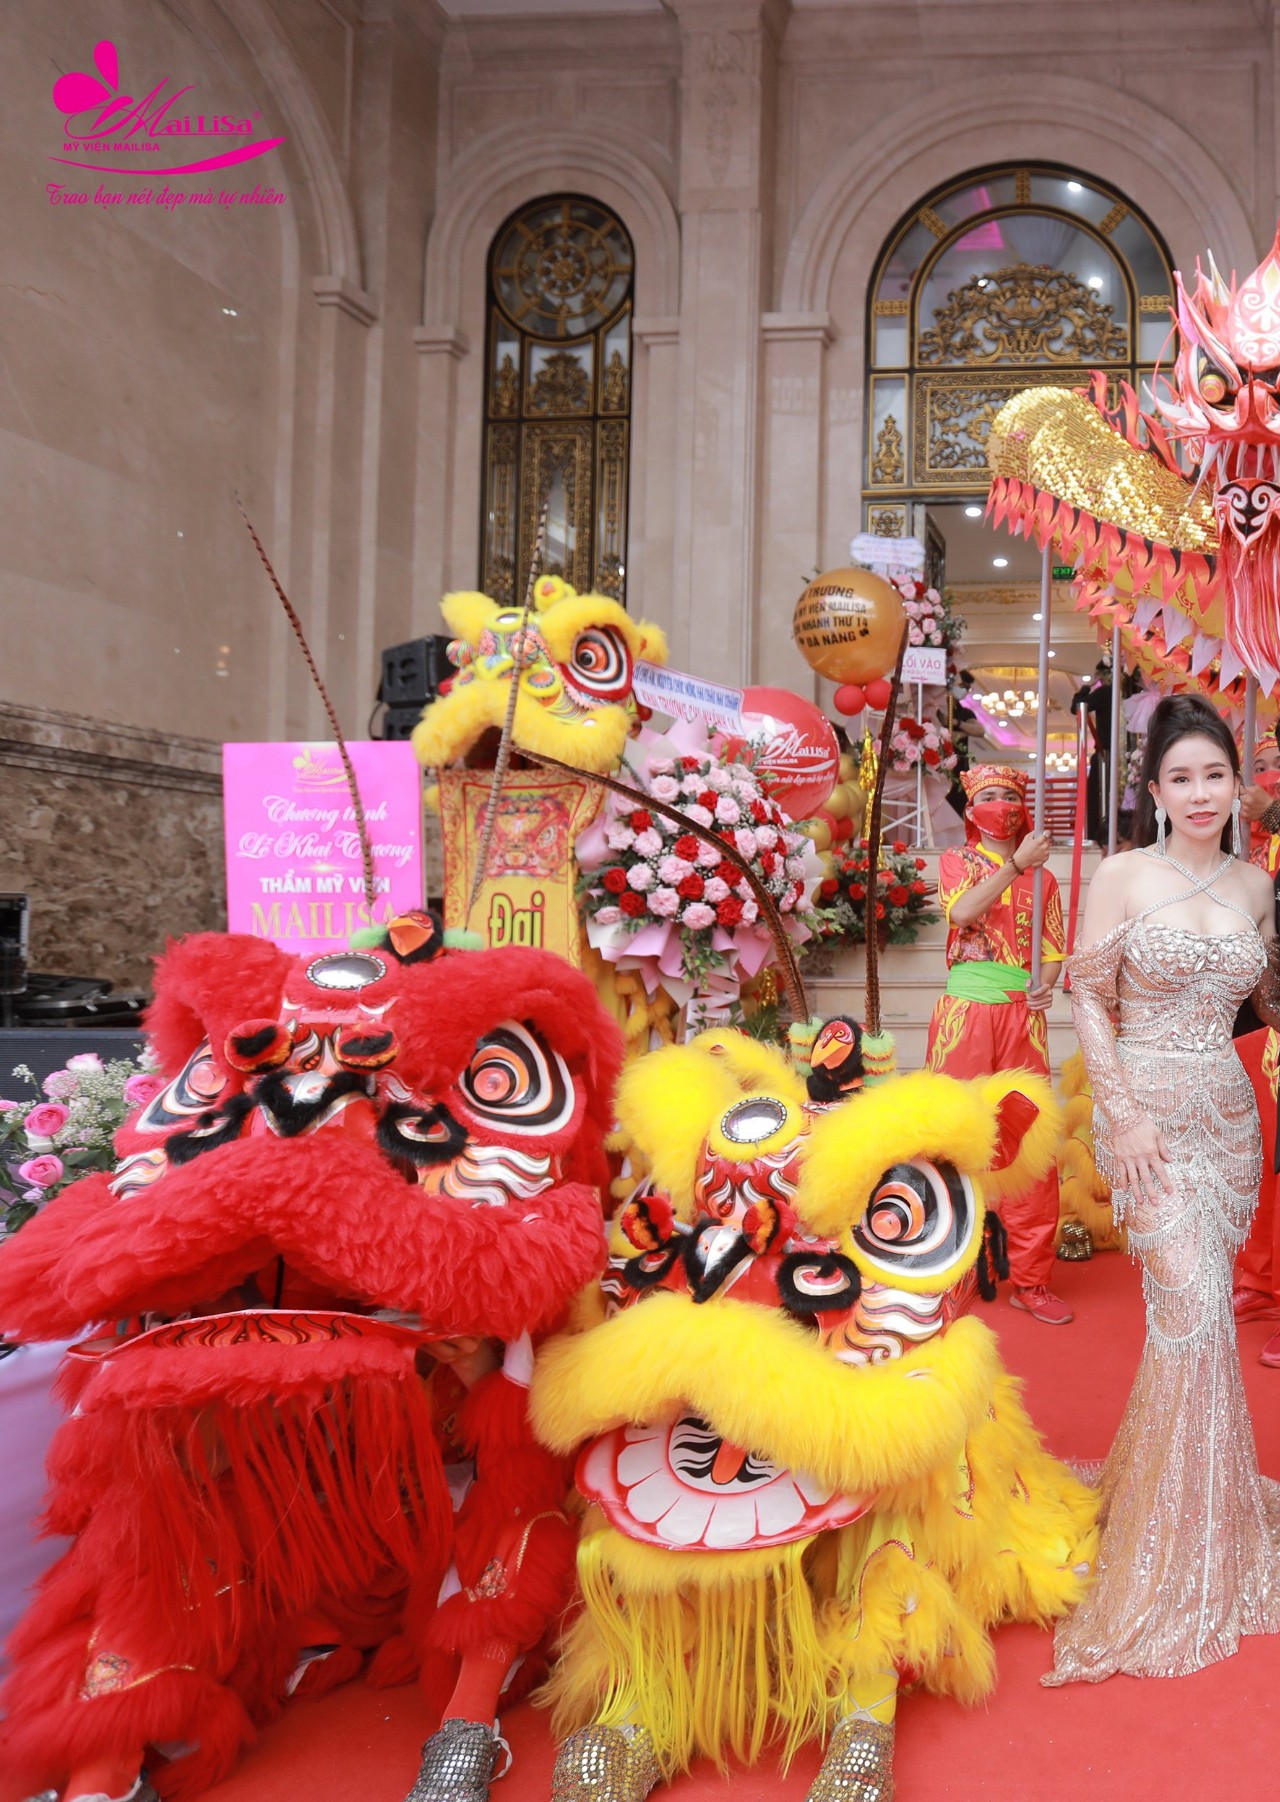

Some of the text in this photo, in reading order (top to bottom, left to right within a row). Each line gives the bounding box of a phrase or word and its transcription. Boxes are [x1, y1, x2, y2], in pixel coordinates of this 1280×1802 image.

[828, 601, 867, 613] MAILISA
[920, 657, 941, 670] VÀO
[259, 868, 312, 894] THẨM
[316, 873, 345, 894] MỸ
